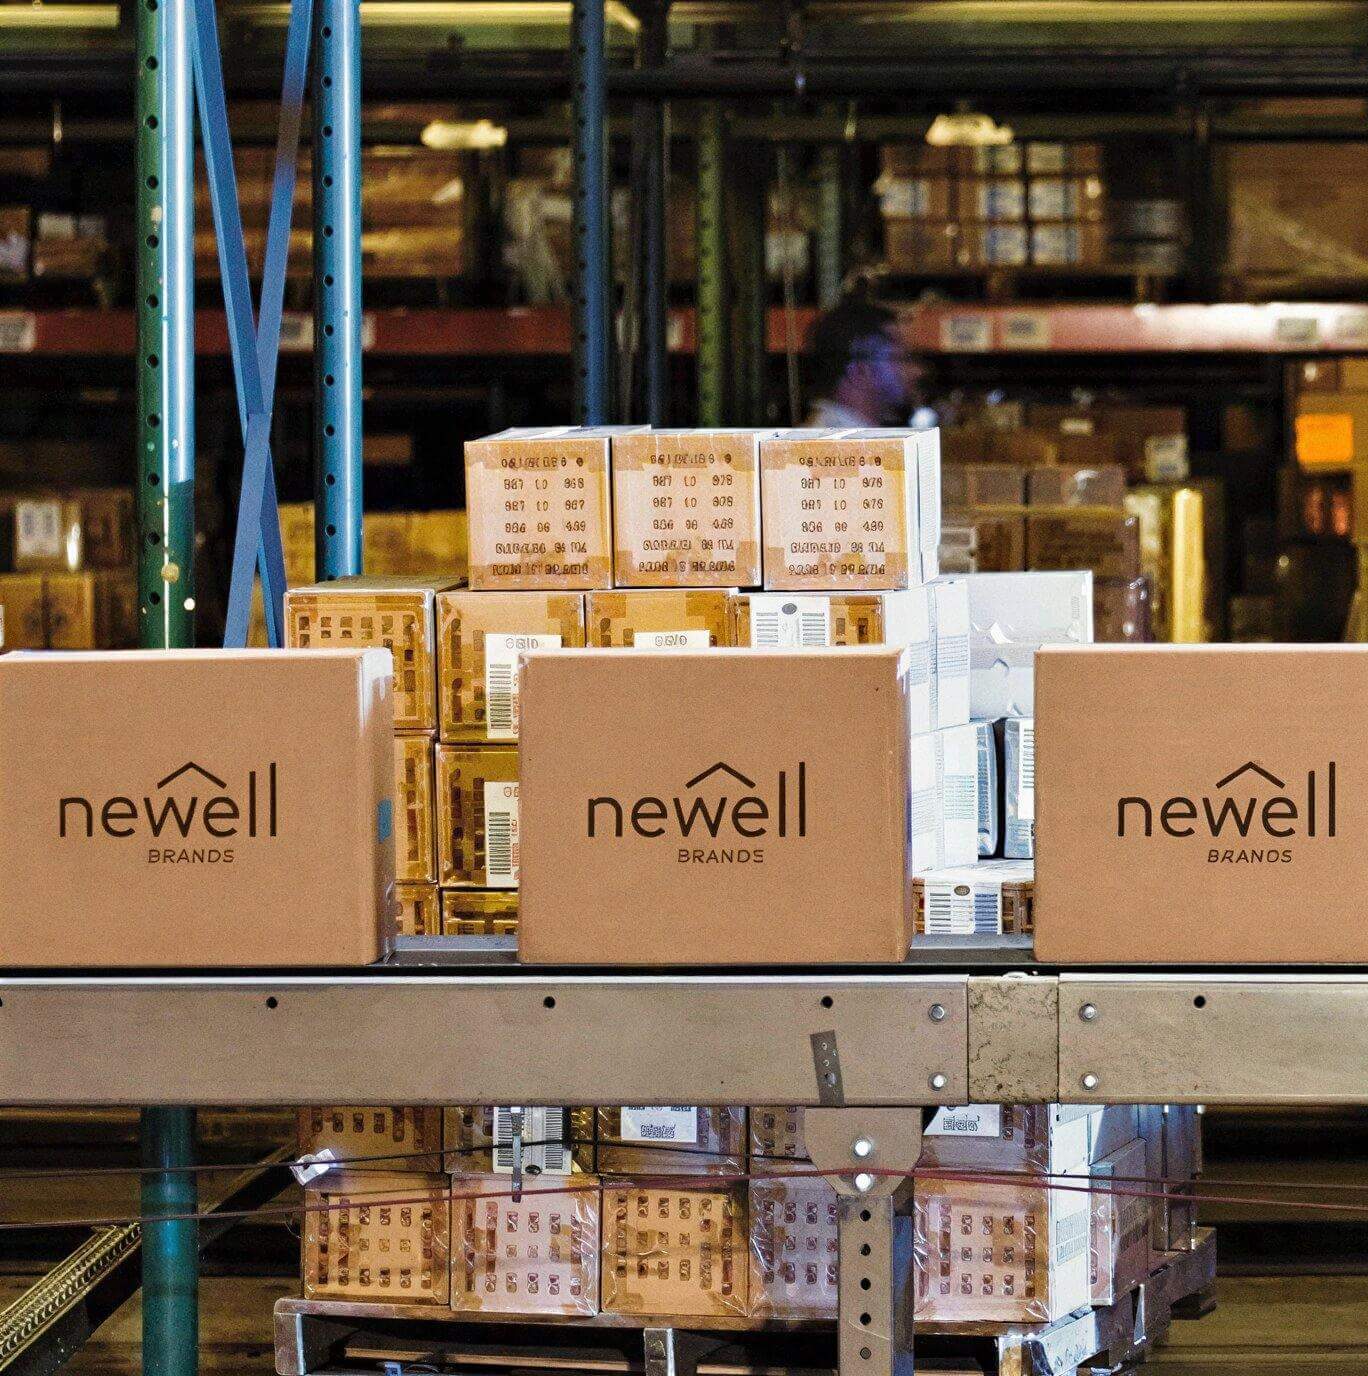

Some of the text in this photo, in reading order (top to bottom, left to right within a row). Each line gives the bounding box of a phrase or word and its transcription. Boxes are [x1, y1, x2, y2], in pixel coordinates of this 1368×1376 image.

[60, 761, 277, 838] newell
[588, 761, 807, 838] newell
[1117, 761, 1336, 838] newell
[148, 848, 234, 864] BRANDS
[677, 848, 764, 864] BRANDS
